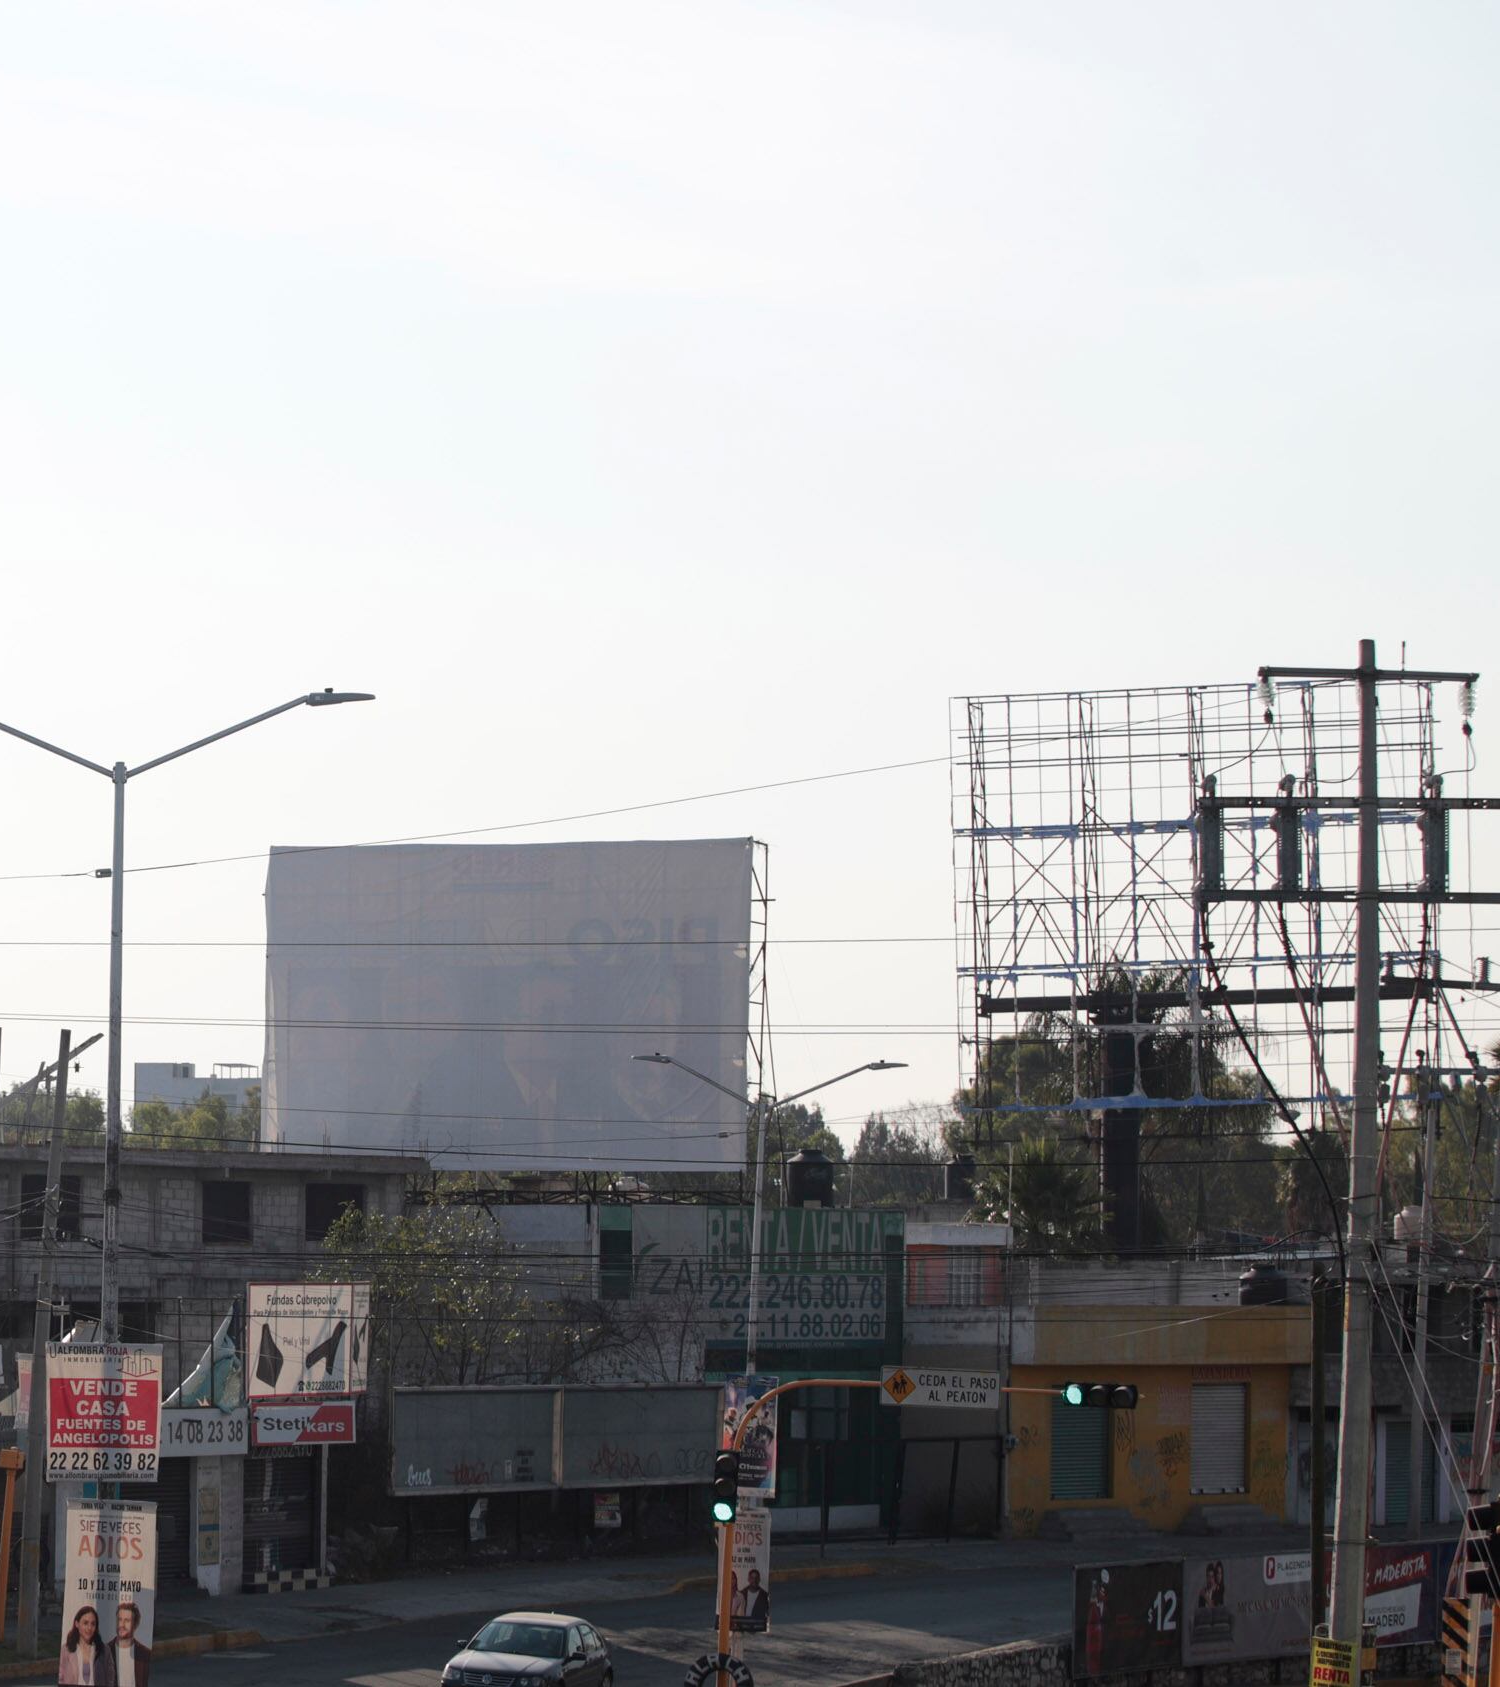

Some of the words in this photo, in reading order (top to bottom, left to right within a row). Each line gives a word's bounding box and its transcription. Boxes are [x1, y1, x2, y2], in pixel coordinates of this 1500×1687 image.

[267, 1294, 294, 1306] Fundas
[295, 1294, 337, 1307] Cubrepolvo
[733, 1313, 881, 1338] 2.11.88.02.06
[57, 1344, 105, 1355] ALFOMBRA
[106, 1346, 128, 1355] ROJA
[69, 1380, 138, 1396] VENDE
[918, 1374, 946, 1387] CEDA
[952, 1376, 964, 1388] EL
[970, 1377, 997, 1390] PASO
[928, 1390, 940, 1402] AL
[946, 1391, 986, 1403] PEATON
[76, 1399, 130, 1416] CASA
[57, 1418, 122, 1430] FUENTES
[126, 1420, 146, 1431] DE
[168, 1421, 183, 1444] 14
[187, 1420, 204, 1443] 08
[208, 1420, 224, 1442] 23
[227, 1420, 244, 1441] 38
[52, 1433, 156, 1445] ANGELOPOLIS
[50, 1452, 67, 1470] 22
[72, 1452, 89, 1470] 22
[93, 1452, 110, 1470] 62
[114, 1452, 132, 1470] 39
[137, 1453, 156, 1470] 82
[80, 1520, 107, 1532] SIETE
[109, 1521, 142, 1535] VECES
[733, 1531, 763, 1546] DIOS
[98, 1564, 104, 1573] LA
[107, 1564, 120, 1573] GIRA
[78, 1578, 88, 1590] 10
[90, 1580, 95, 1590] Y
[108, 1581, 118, 1591] DE
[120, 1581, 141, 1592] MAYO
[1368, 1613, 1405, 1627] MADERO
[1313, 1667, 1350, 1684] RENTA
